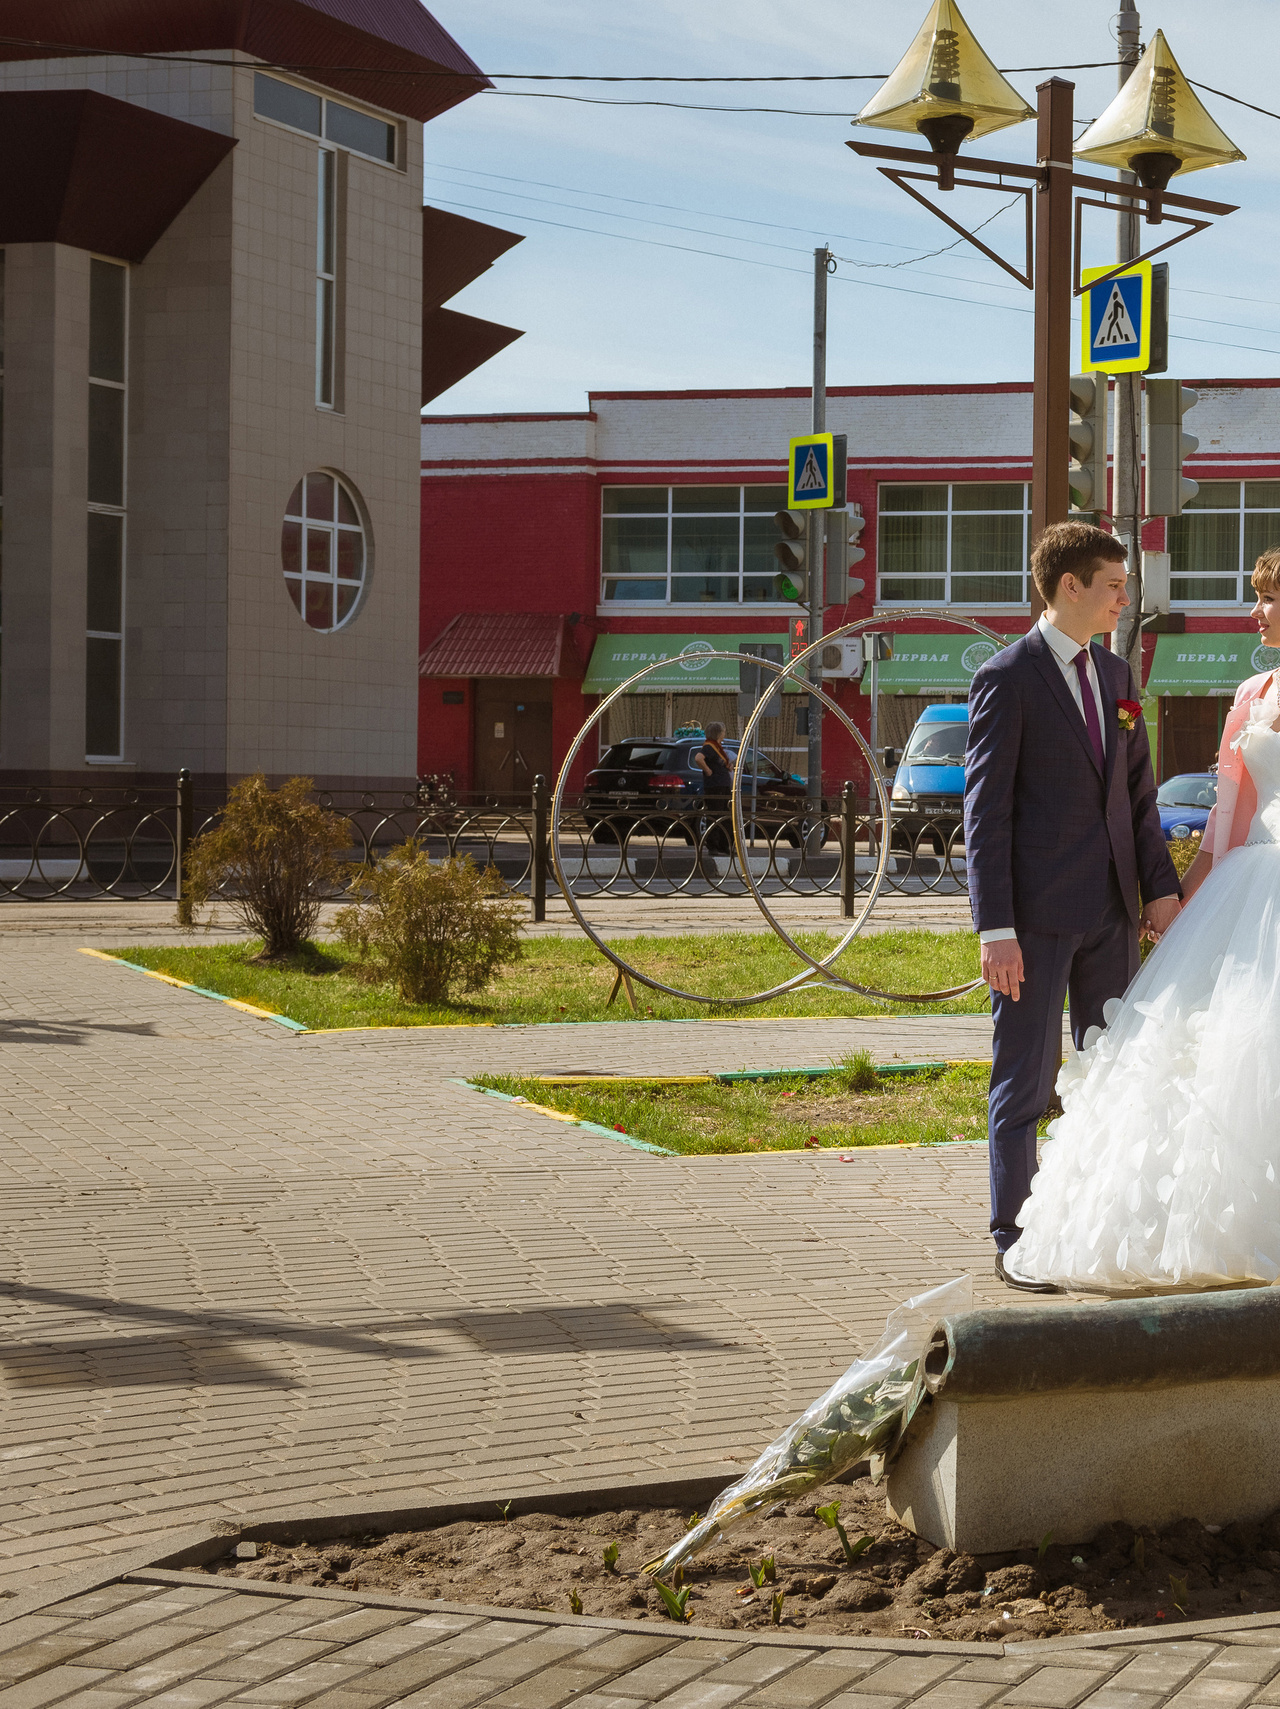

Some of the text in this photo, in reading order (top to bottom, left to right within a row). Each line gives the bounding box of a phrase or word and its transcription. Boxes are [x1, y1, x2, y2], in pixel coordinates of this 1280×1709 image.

[612, 653, 668, 661] ПЕРВАЯ
[891, 653, 949, 662] ПЕРВАЯ
[1177, 653, 1238, 662] ПЕРВАЯ
